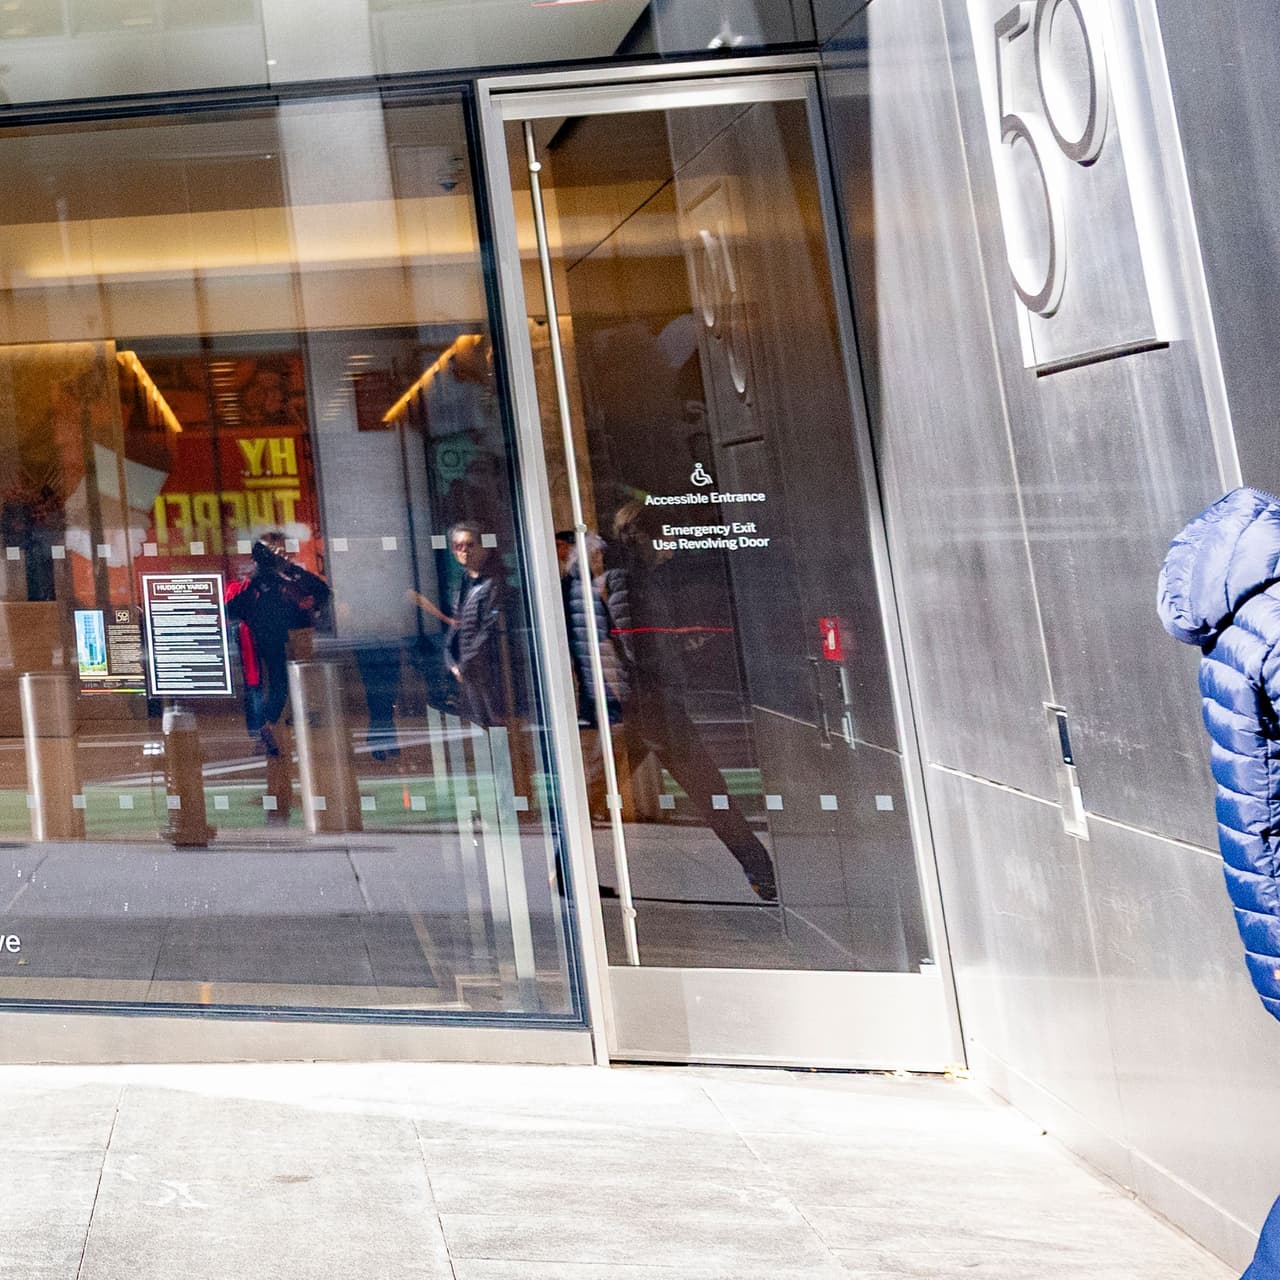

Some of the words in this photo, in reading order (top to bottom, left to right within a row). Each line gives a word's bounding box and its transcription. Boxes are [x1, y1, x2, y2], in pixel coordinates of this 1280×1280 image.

[644, 492, 709, 506] Accessible
[710, 491, 766, 504] Entrance
[662, 523, 731, 537] Emergency
[732, 522, 757, 534] Exit
[652, 538, 678, 551] Use
[679, 537, 738, 551] Revolving
[739, 536, 770, 548] Door
